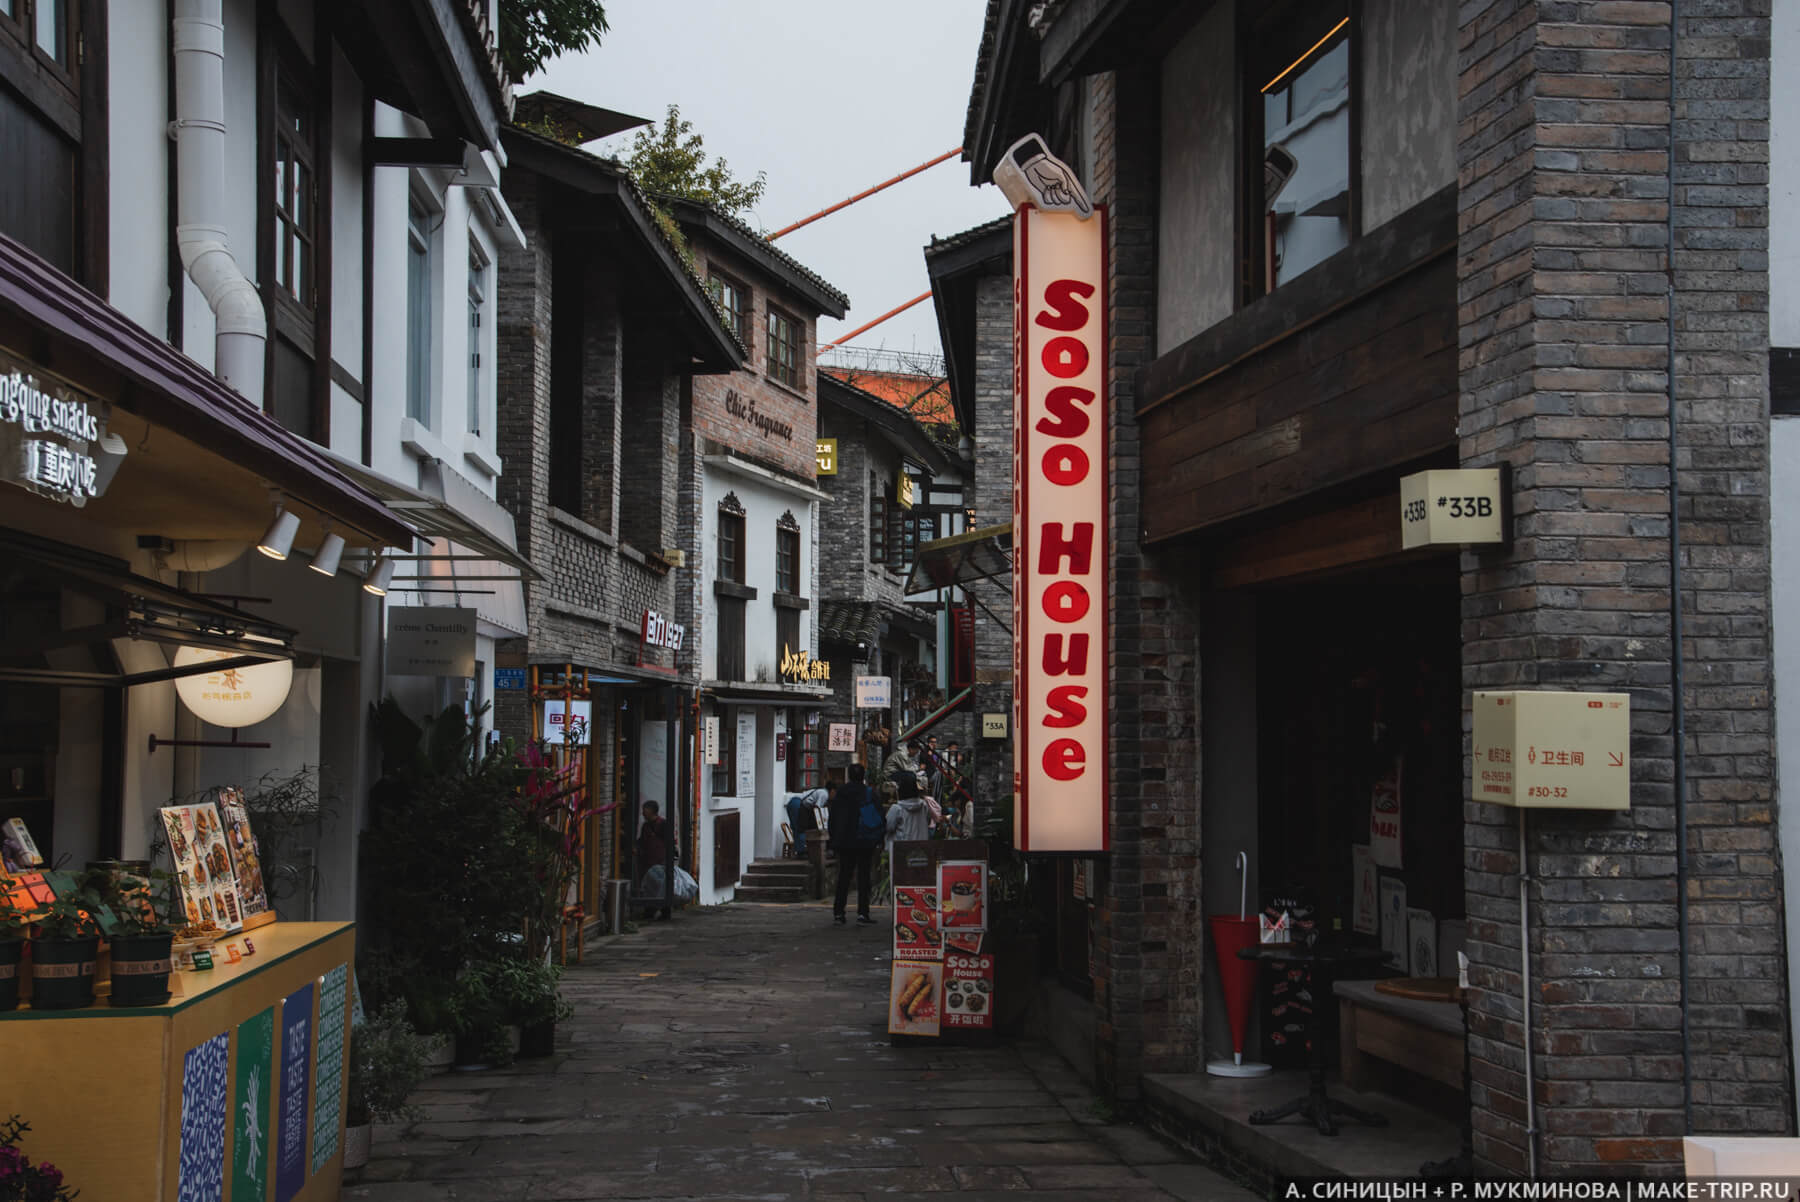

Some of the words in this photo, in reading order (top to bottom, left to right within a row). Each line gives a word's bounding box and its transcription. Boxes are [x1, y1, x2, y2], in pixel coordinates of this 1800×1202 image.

[52, 398, 98, 442] snacks
[726, 388, 747, 420] Chic
[748, 399, 793, 441] Fragrance
[1404, 499, 1426, 523] #33B
[1437, 495, 1493, 518] #33B
[1038, 521, 1095, 781] House
[498, 679, 510, 688] 45
[985, 722, 1005, 730] #33A
[1540, 751, 1585, 767] 卫生间
[1528, 786, 1568, 798] #30-32
[946, 955, 990, 969] SoSo
[952, 968, 984, 977] House
[289, 1018, 306, 1060] TASTE
[287, 1057, 304, 1092] TASTE
[286, 1087, 303, 1114] TASTE
